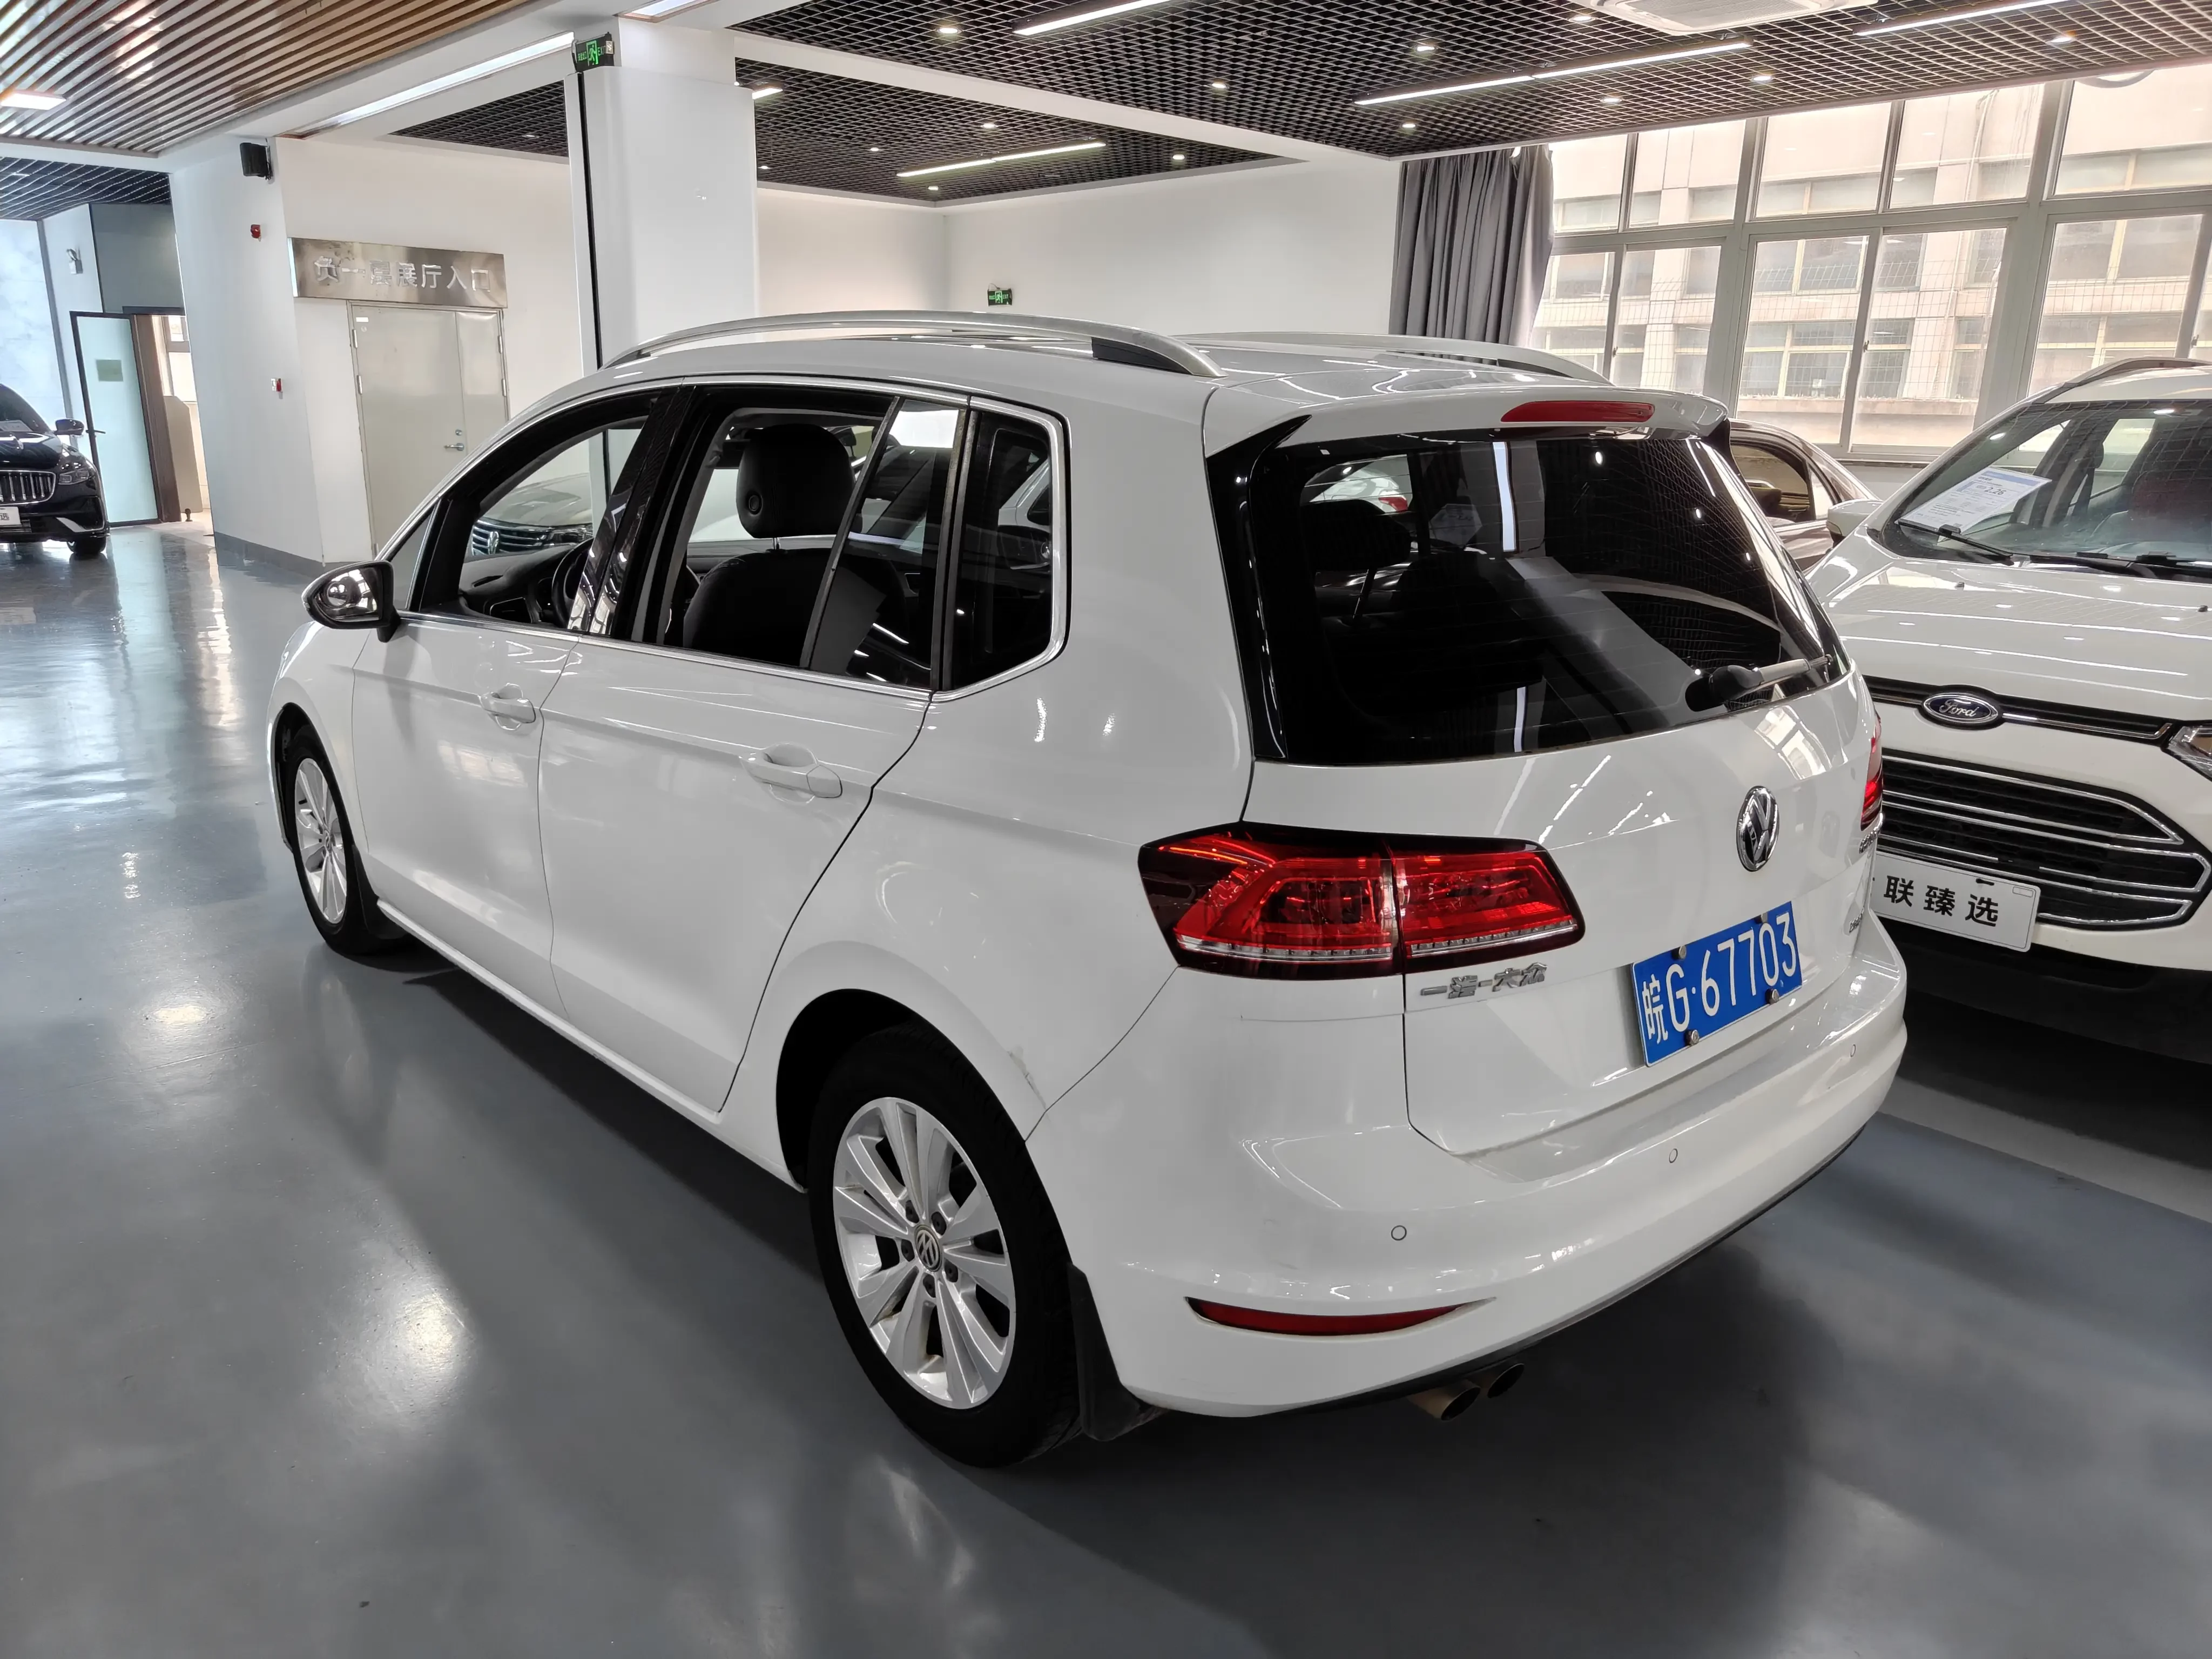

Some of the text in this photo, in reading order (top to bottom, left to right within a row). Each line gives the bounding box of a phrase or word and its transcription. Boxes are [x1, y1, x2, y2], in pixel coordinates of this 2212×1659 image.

[314, 256, 490, 292] 负一层展厅入口
[1939, 699, 1980, 717] Ford
[1871, 875, 1999, 927] 联臻选
